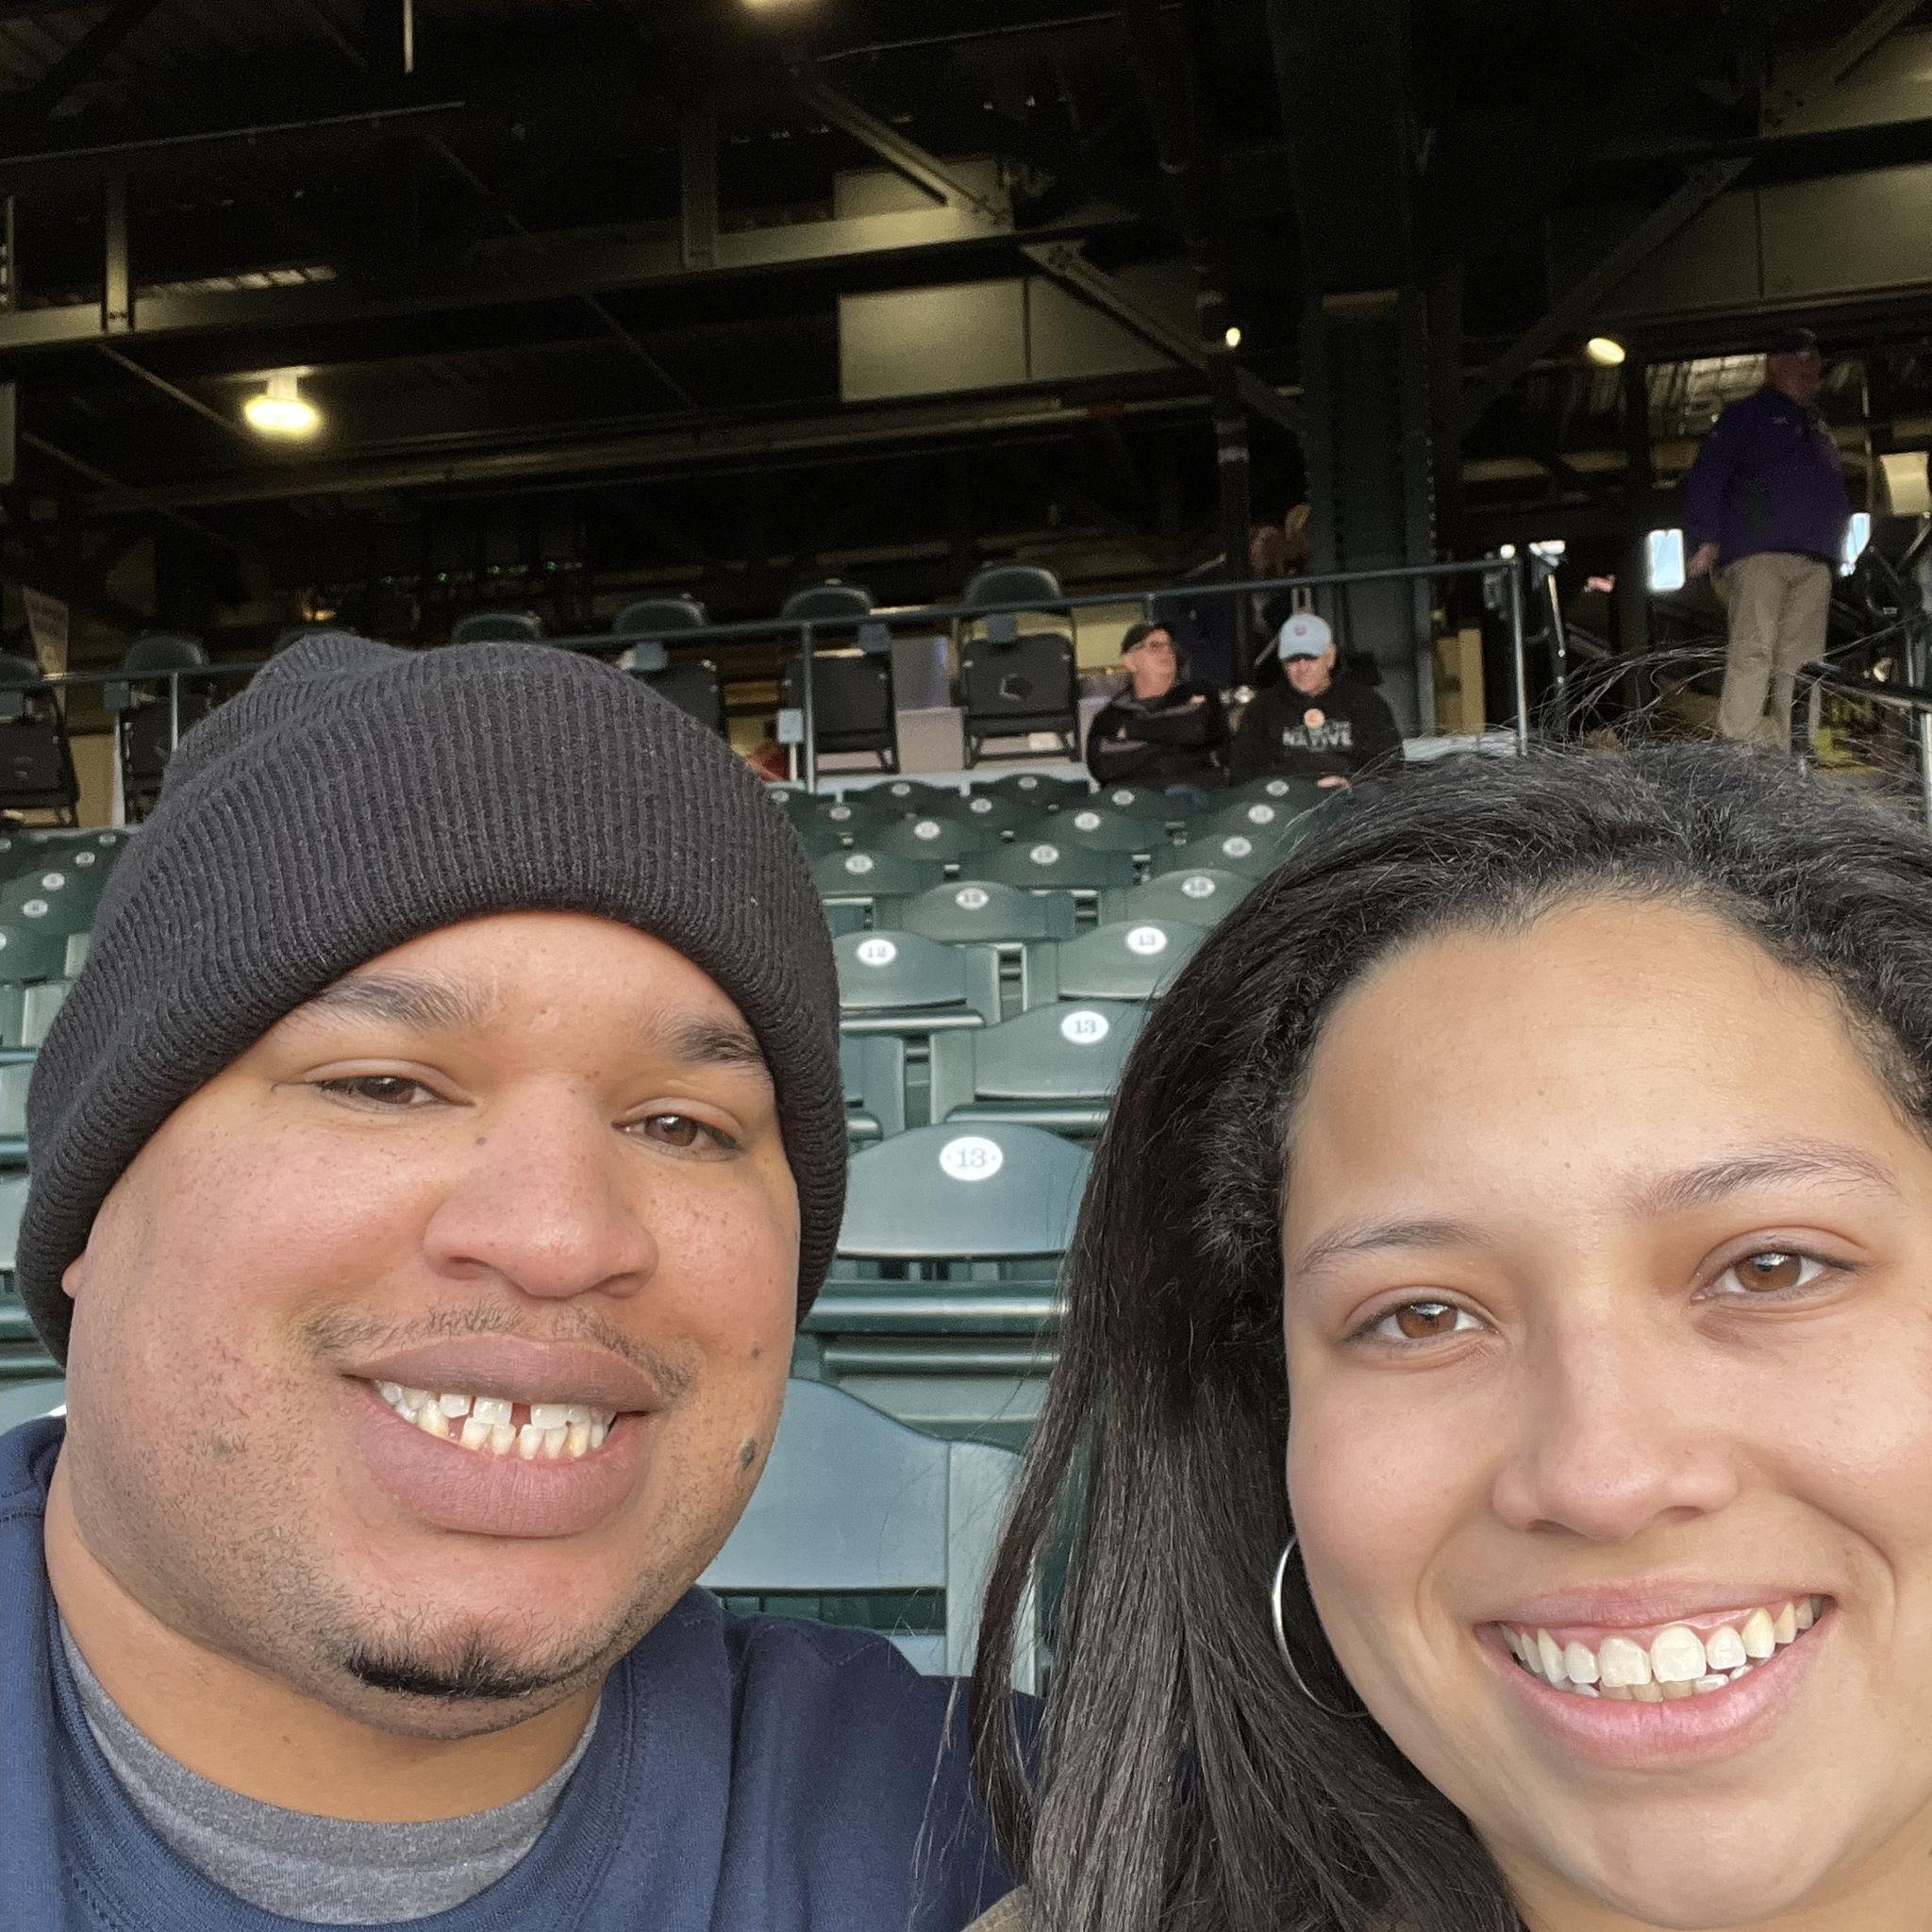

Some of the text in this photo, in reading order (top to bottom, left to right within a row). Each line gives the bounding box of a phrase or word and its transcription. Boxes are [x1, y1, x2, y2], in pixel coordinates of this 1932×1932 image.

[1138, 933, 1156, 946] 13
[867, 946, 887, 958] 12
[1074, 1018, 1097, 1035] 13
[957, 1147, 987, 1168] 13
